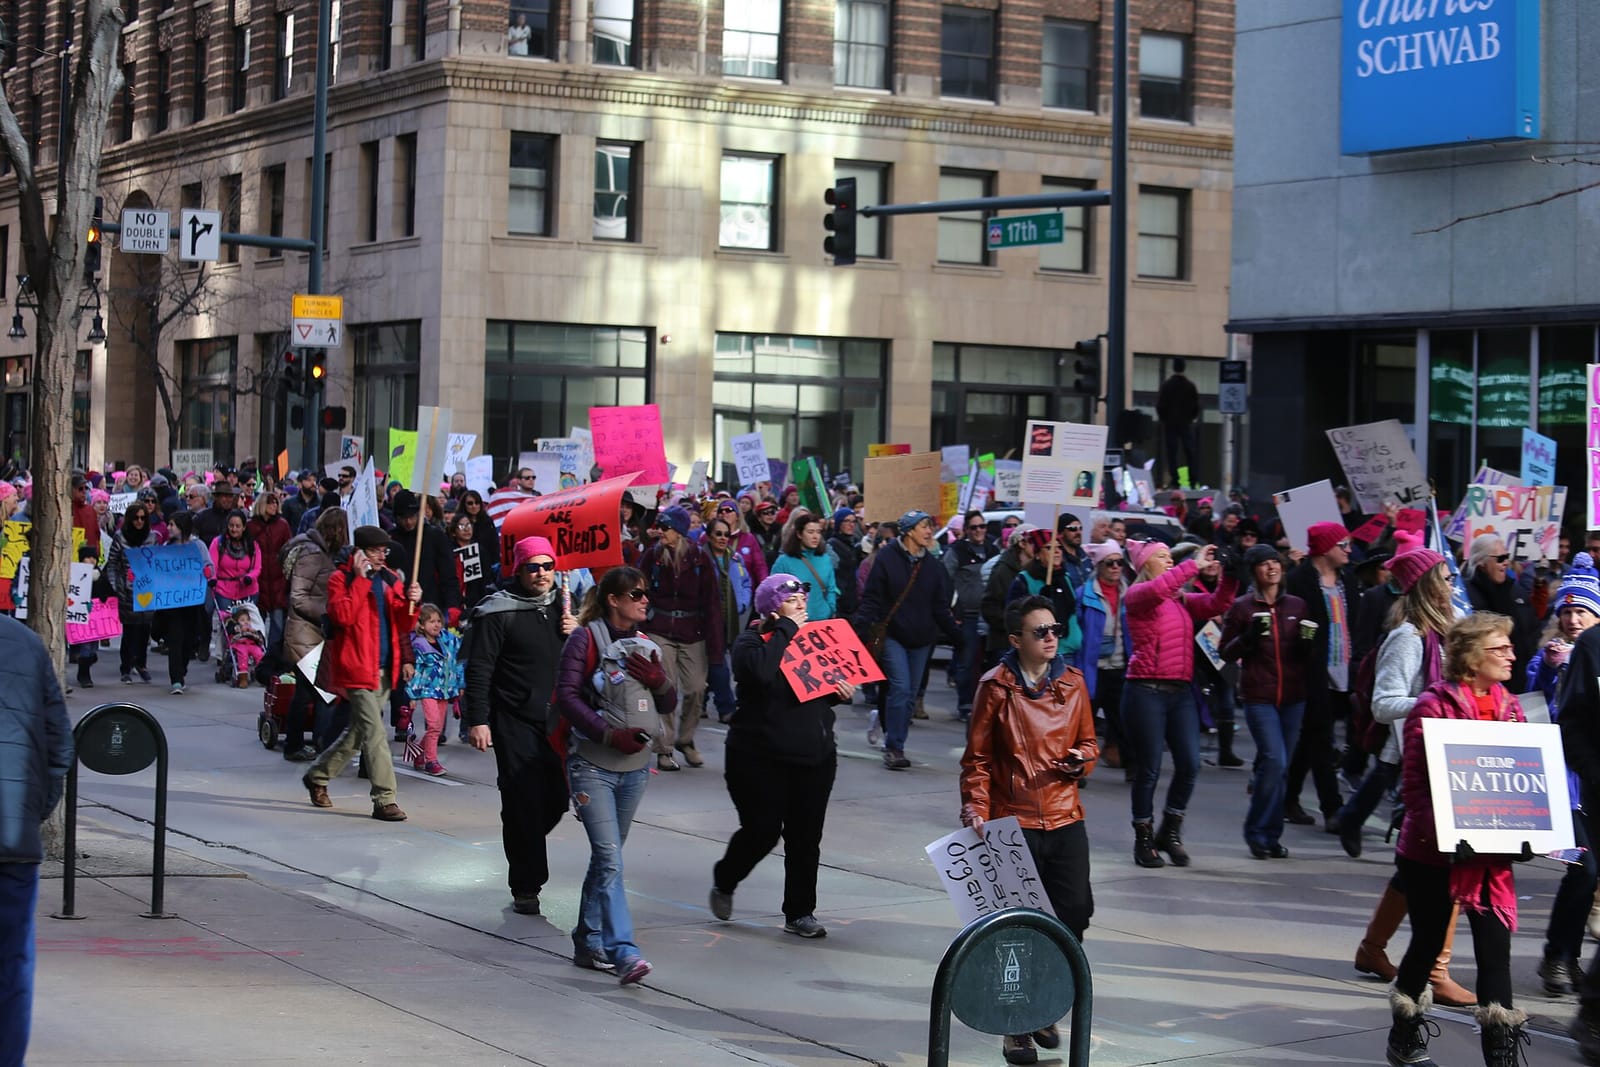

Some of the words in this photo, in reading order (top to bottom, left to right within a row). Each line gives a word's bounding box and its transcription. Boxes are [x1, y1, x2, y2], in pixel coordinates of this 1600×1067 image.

[1357, 21, 1501, 78] SCHWAB
[135, 213, 157, 226] NO
[126, 227, 165, 239] DOUBLE
[1007, 219, 1038, 243] 17th
[132, 239, 160, 249] TURN
[1394, 484, 1423, 504] WE
[1466, 486, 1566, 522] RADIATE
[543, 510, 572, 525] ARE
[556, 524, 610, 557] RIGHTS
[154, 557, 203, 573] RIGHTS
[154, 587, 205, 607] RIGHTS
[1448, 771, 1548, 793] NATION
[1004, 983, 1020, 992] BID
